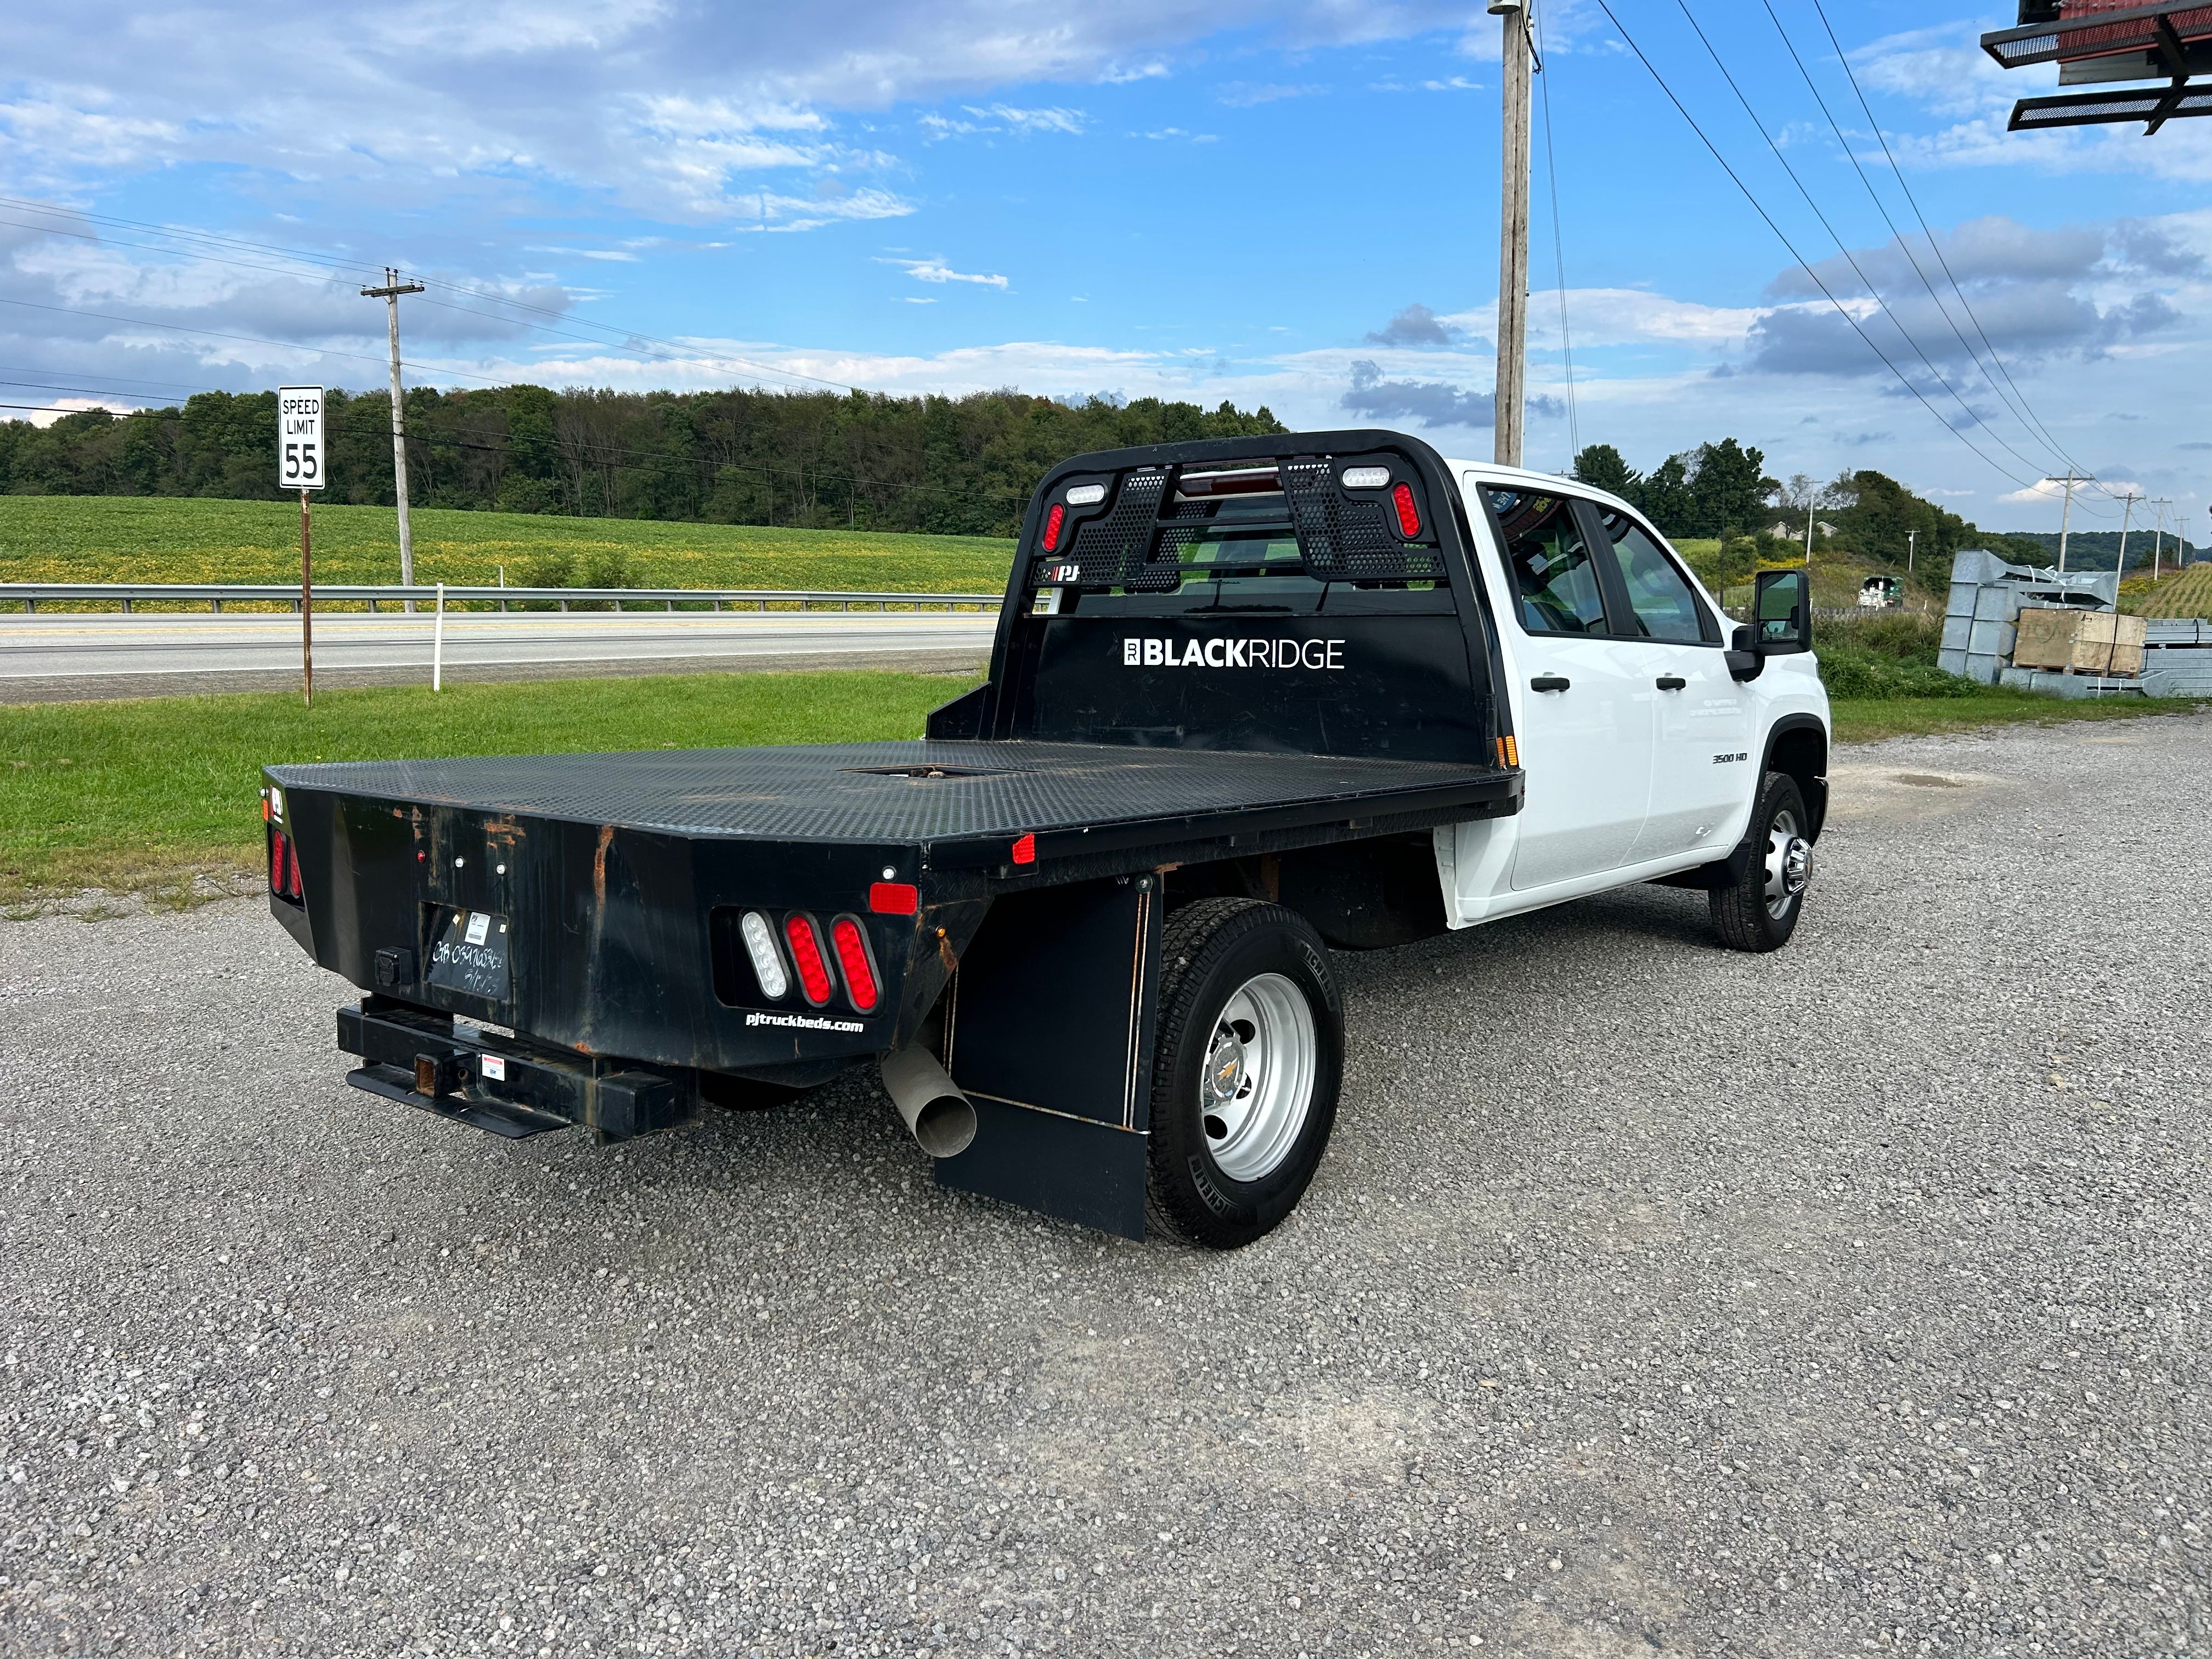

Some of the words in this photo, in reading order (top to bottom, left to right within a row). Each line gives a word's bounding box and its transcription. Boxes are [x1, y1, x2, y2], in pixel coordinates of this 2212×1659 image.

[283, 399, 319, 414] SPEED
[287, 420, 315, 435] LIMIT
[286, 444, 317, 479] 55
[1057, 565, 1079, 582] PJ
[1144, 639, 1346, 669] BLACKRIDGE
[1712, 754, 1734, 764] 3500
[1735, 753, 1747, 761] HD
[1298, 942, 1338, 1008] MICHELIN
[746, 1012, 864, 1032] pjtruckbeds.com
[1190, 1158, 1239, 1224] MICHELIN
